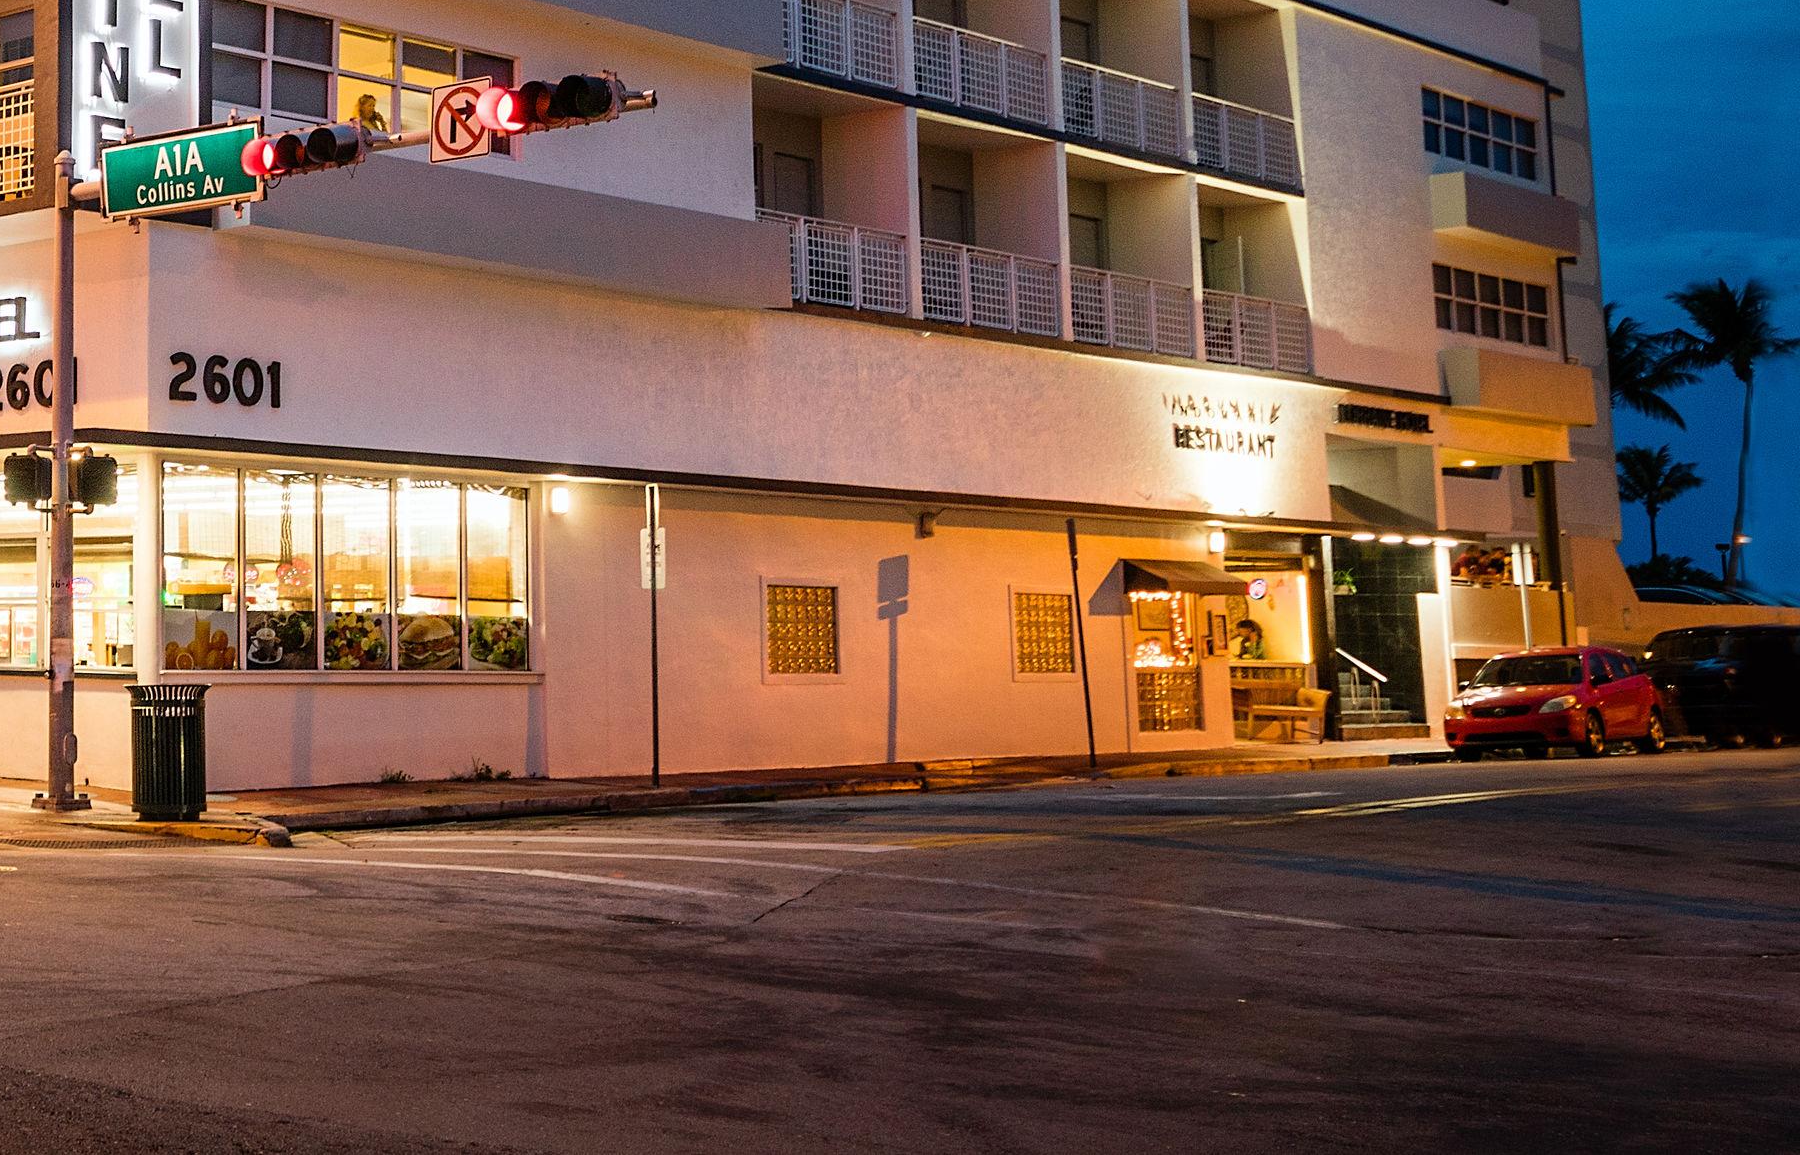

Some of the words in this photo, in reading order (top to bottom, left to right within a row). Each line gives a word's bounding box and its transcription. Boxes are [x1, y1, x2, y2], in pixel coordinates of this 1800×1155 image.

[153, 141, 205, 180] A1A
[137, 180, 196, 205] Collins
[202, 175, 224, 195] Av
[168, 351, 281, 409] 2601
[1172, 423, 1276, 458] RESTAURANT
